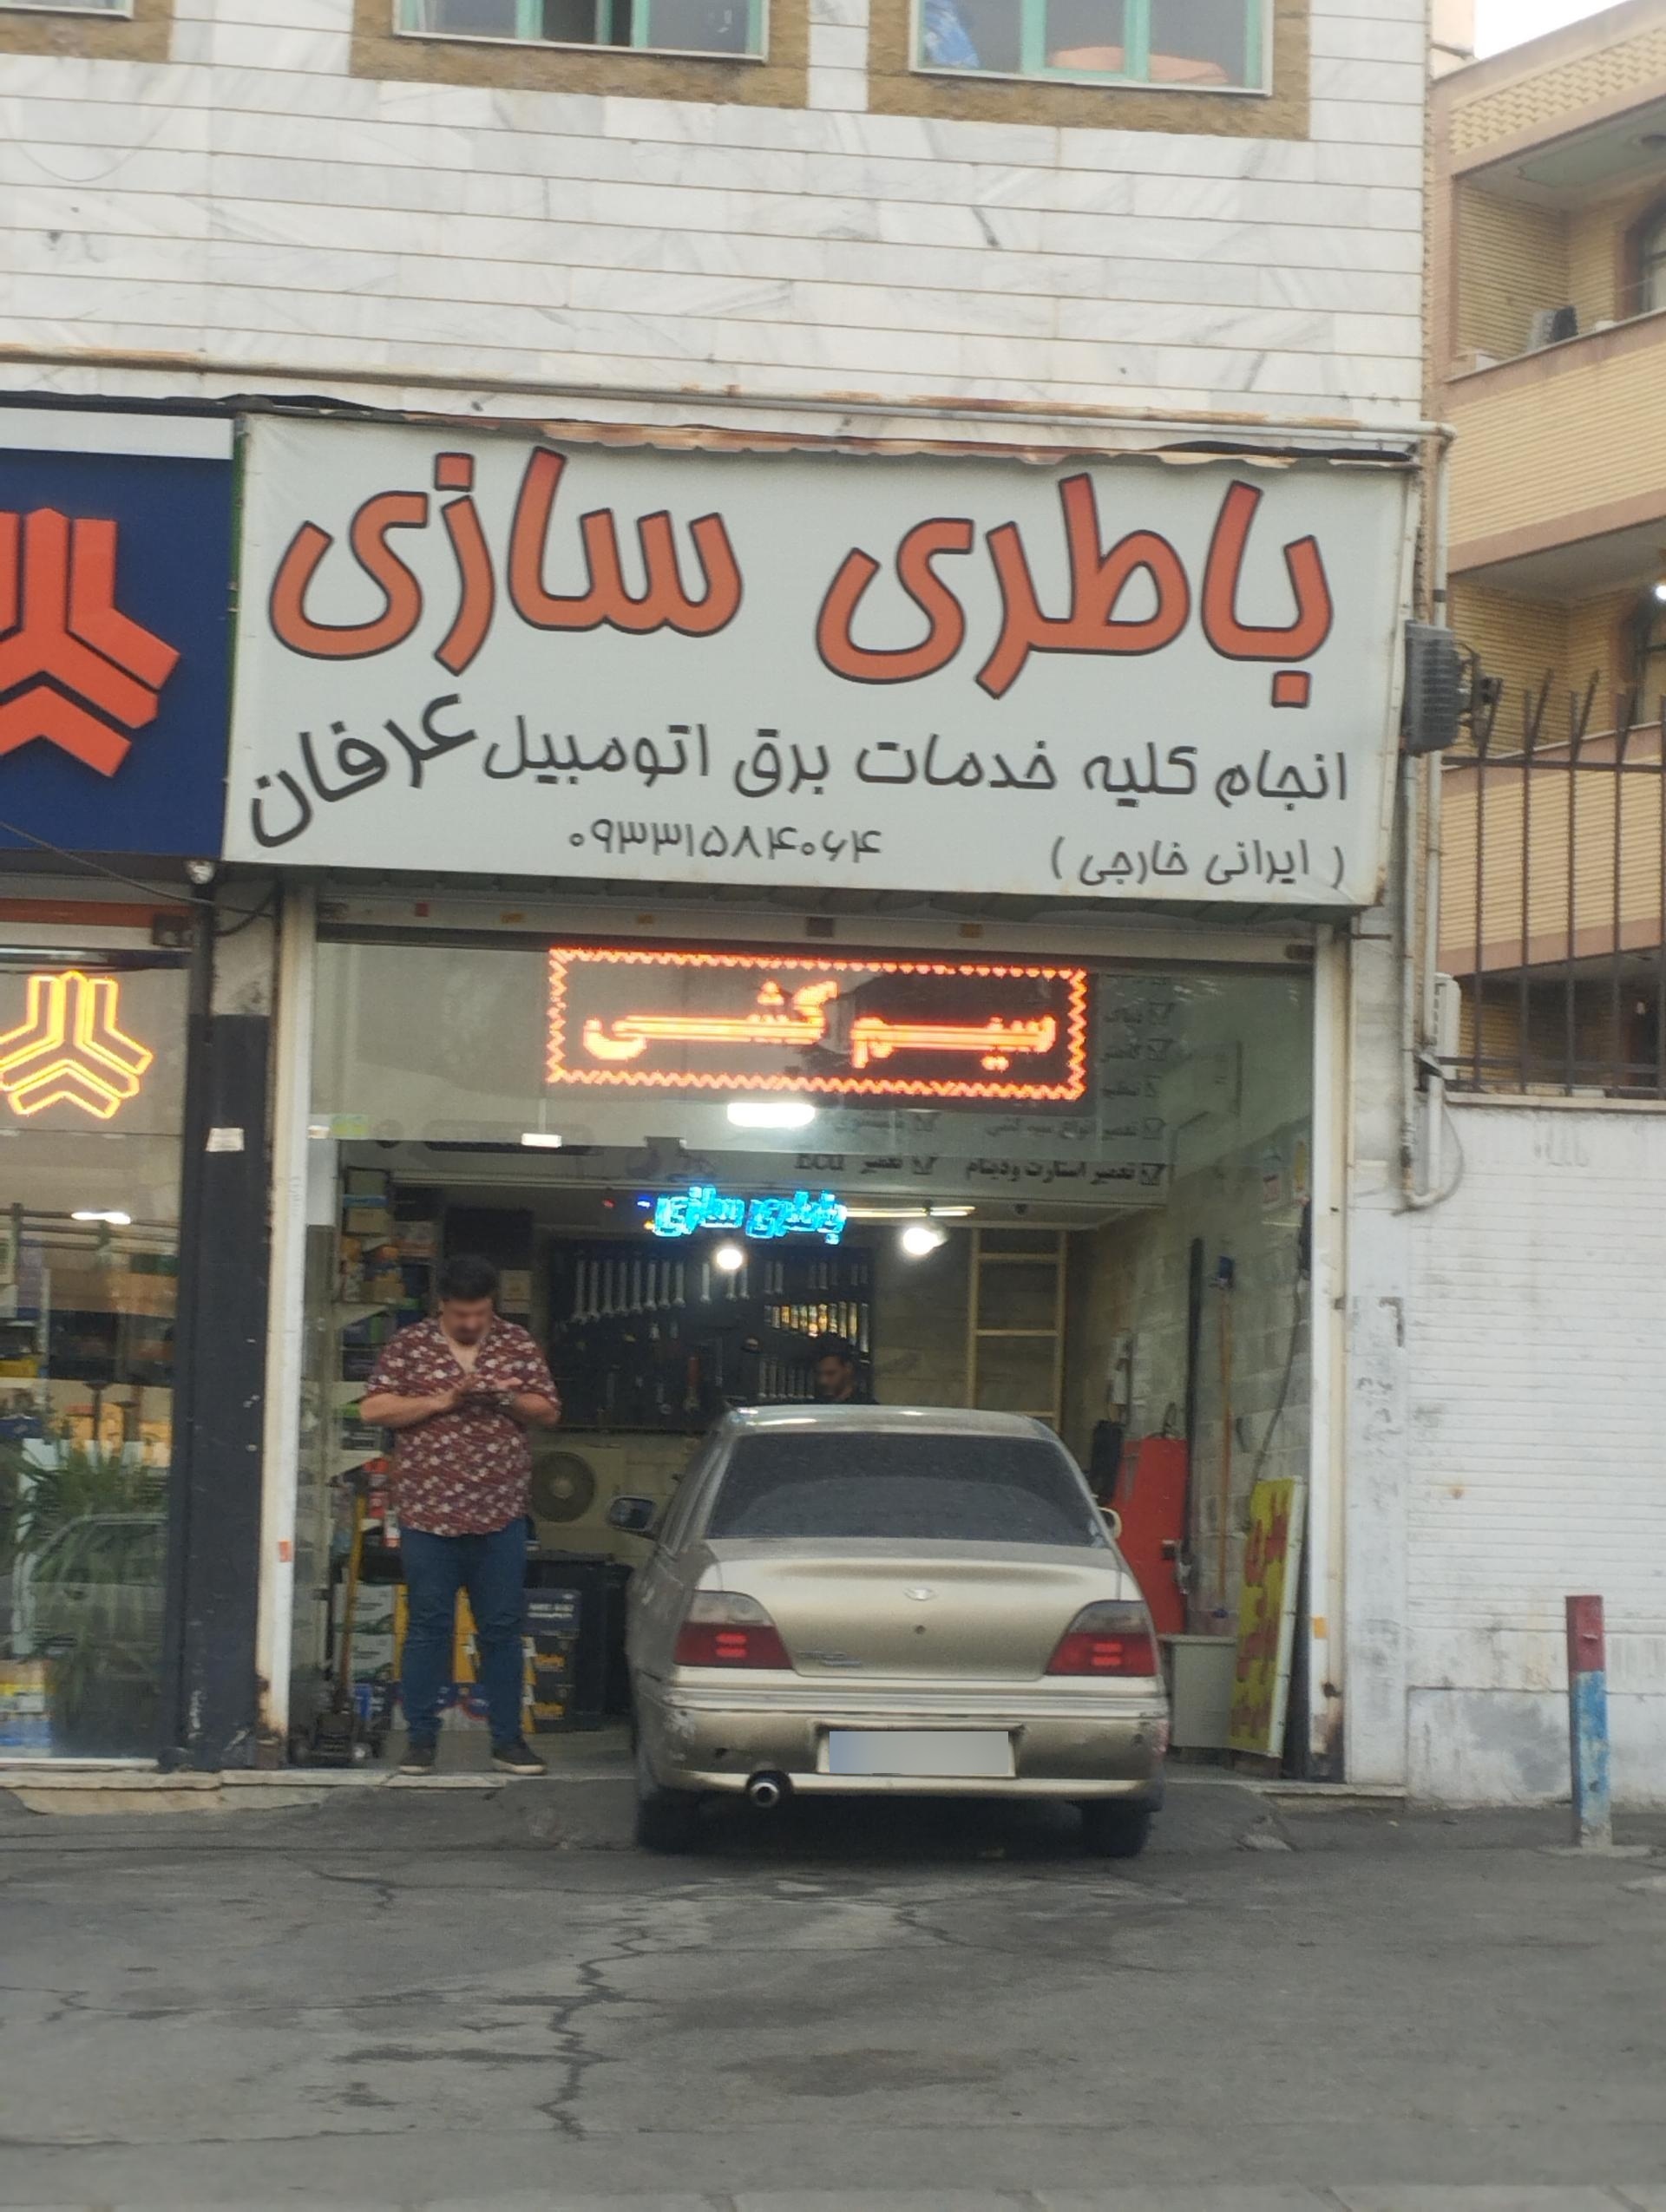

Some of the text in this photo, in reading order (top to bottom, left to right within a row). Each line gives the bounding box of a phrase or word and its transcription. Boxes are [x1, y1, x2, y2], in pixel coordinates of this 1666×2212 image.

[268, 446, 1335, 710] باطری سازی
[251, 692, 479, 849] عرفان
[482, 713, 1348, 810] انجام کلیه خدمات برق اتومبیل
[568, 817, 882, 864] ۰۹۳۳۱۵۸۴۰۶۴
[1079, 839, 1189, 887] خارجی
[1204, 839, 1309, 886] ایرانی
[582, 979, 1057, 1070] سیم کشی
